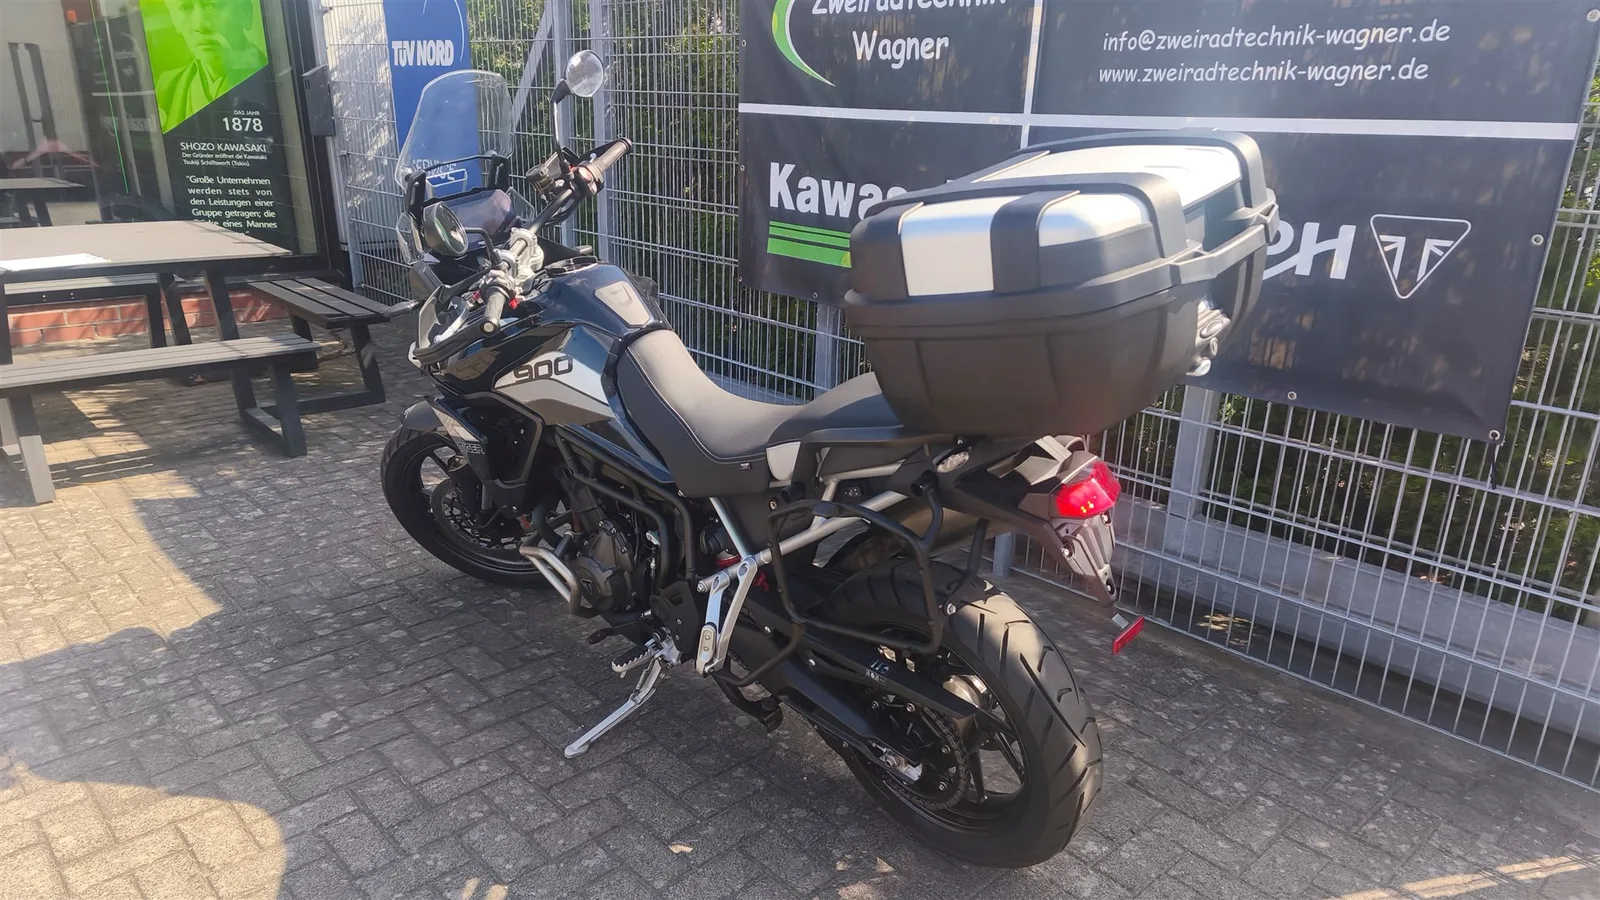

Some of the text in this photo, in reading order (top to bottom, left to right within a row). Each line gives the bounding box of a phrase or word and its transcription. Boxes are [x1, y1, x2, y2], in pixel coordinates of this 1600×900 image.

[1103, 18, 1451, 52] info@zweiradtechnik-wagner.de
[391, 39, 455, 67] TÜV NORD
[852, 29, 949, 69] Wagner
[1098, 57, 1429, 86] www.zweiradtechnik-wagner.de
[222, 116, 264, 132] 1878
[180, 142, 267, 153] SHOZO KAWASAKI
[216, 176, 271, 185] Unternehmen
[187, 187, 273, 197] werden stets von
[769, 161, 908, 221] Kawa
[190, 198, 275, 208] den Leistungen einer
[191, 208, 223, 218] Gruppe
[224, 210, 262, 219] getragen;
[222, 219, 243, 228] eines
[246, 220, 278, 229] Mannes
[512, 355, 574, 383] 900
